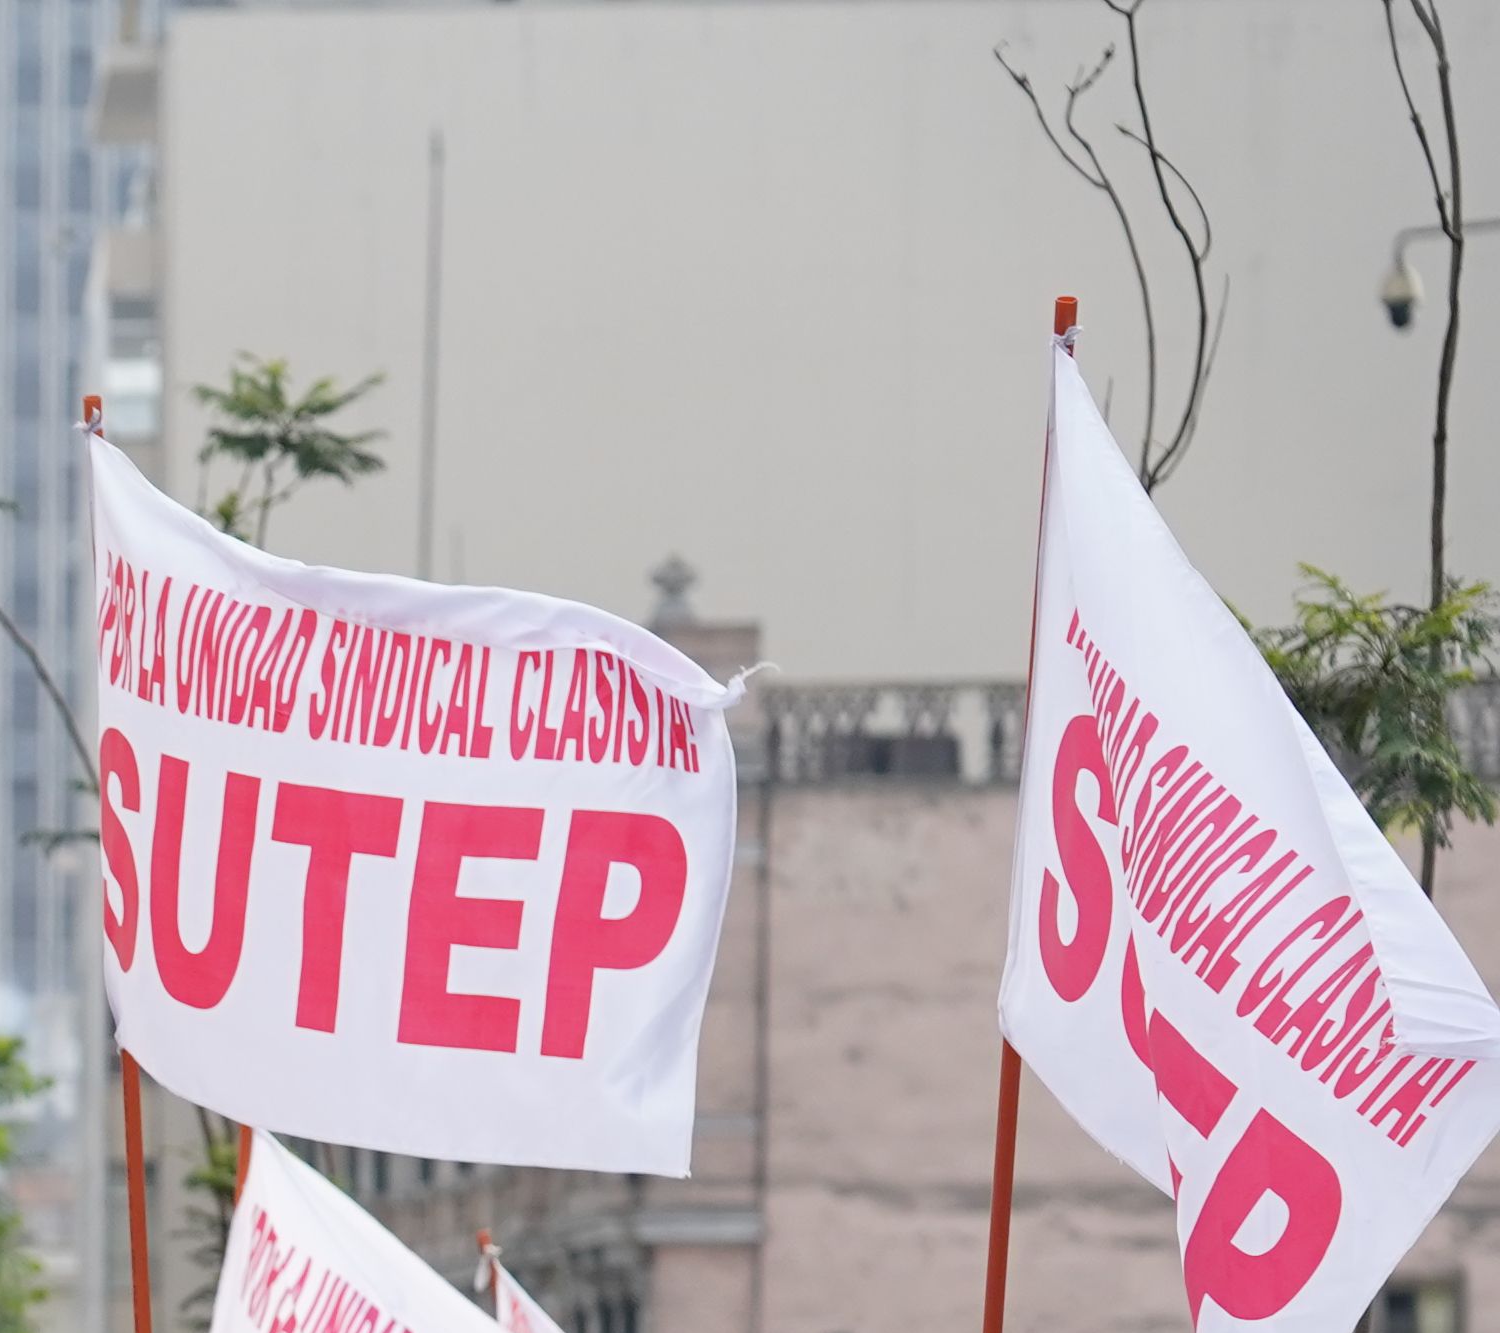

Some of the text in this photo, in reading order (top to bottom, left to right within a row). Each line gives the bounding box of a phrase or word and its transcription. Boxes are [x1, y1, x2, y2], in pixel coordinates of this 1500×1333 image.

[137, 570, 173, 706] LA
[176, 583, 318, 733] UNIDAD
[308, 618, 495, 760] SINDICAL
[508, 648, 701, 774] CLASISTA!
[100, 727, 690, 1061] SUTEP
[1122, 745, 1315, 995] SINDICAL
[1235, 895, 1478, 1149] CLASISTA!
